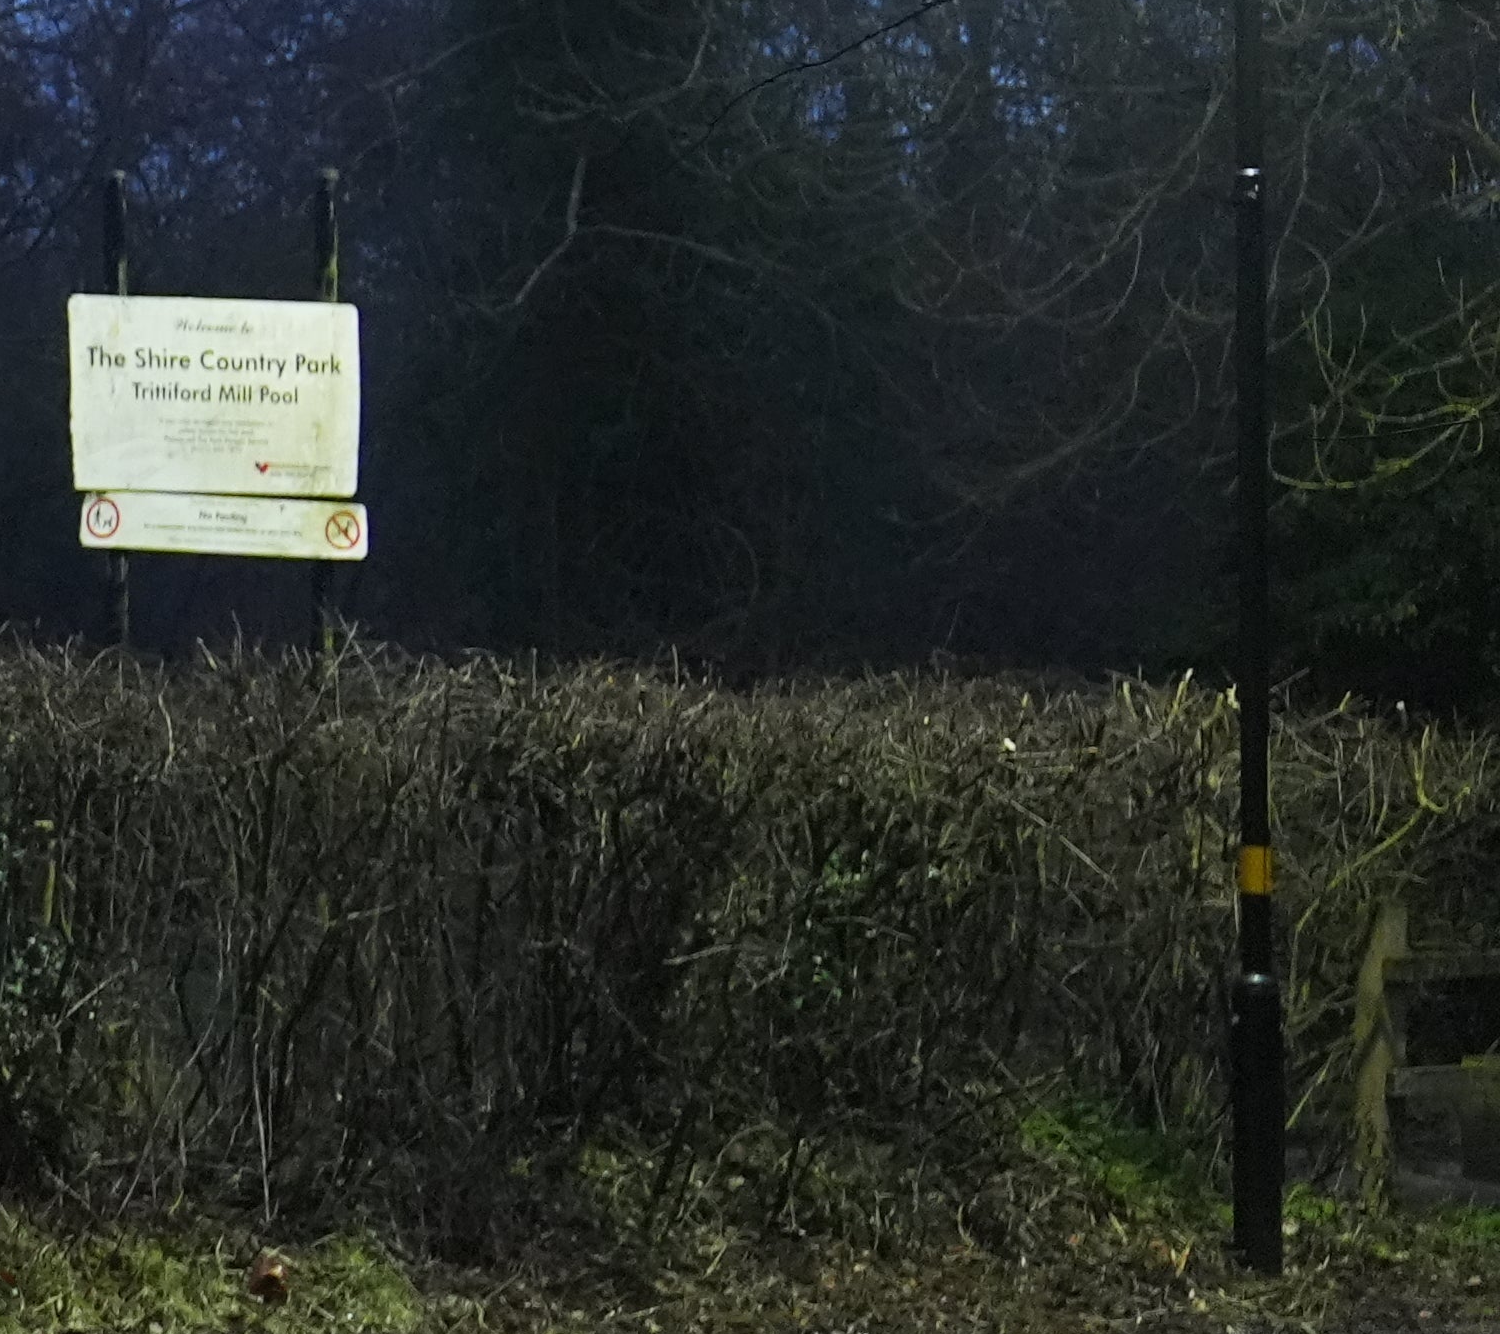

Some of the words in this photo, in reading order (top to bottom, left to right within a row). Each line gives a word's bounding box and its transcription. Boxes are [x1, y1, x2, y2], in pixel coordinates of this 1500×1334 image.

[86, 345, 126, 368] The
[135, 347, 191, 369] Shire
[200, 349, 286, 378] Country
[296, 352, 341, 374] Park
[132, 381, 211, 402] Trittiford
[219, 384, 252, 404] Mill
[260, 385, 298, 404] Pool
